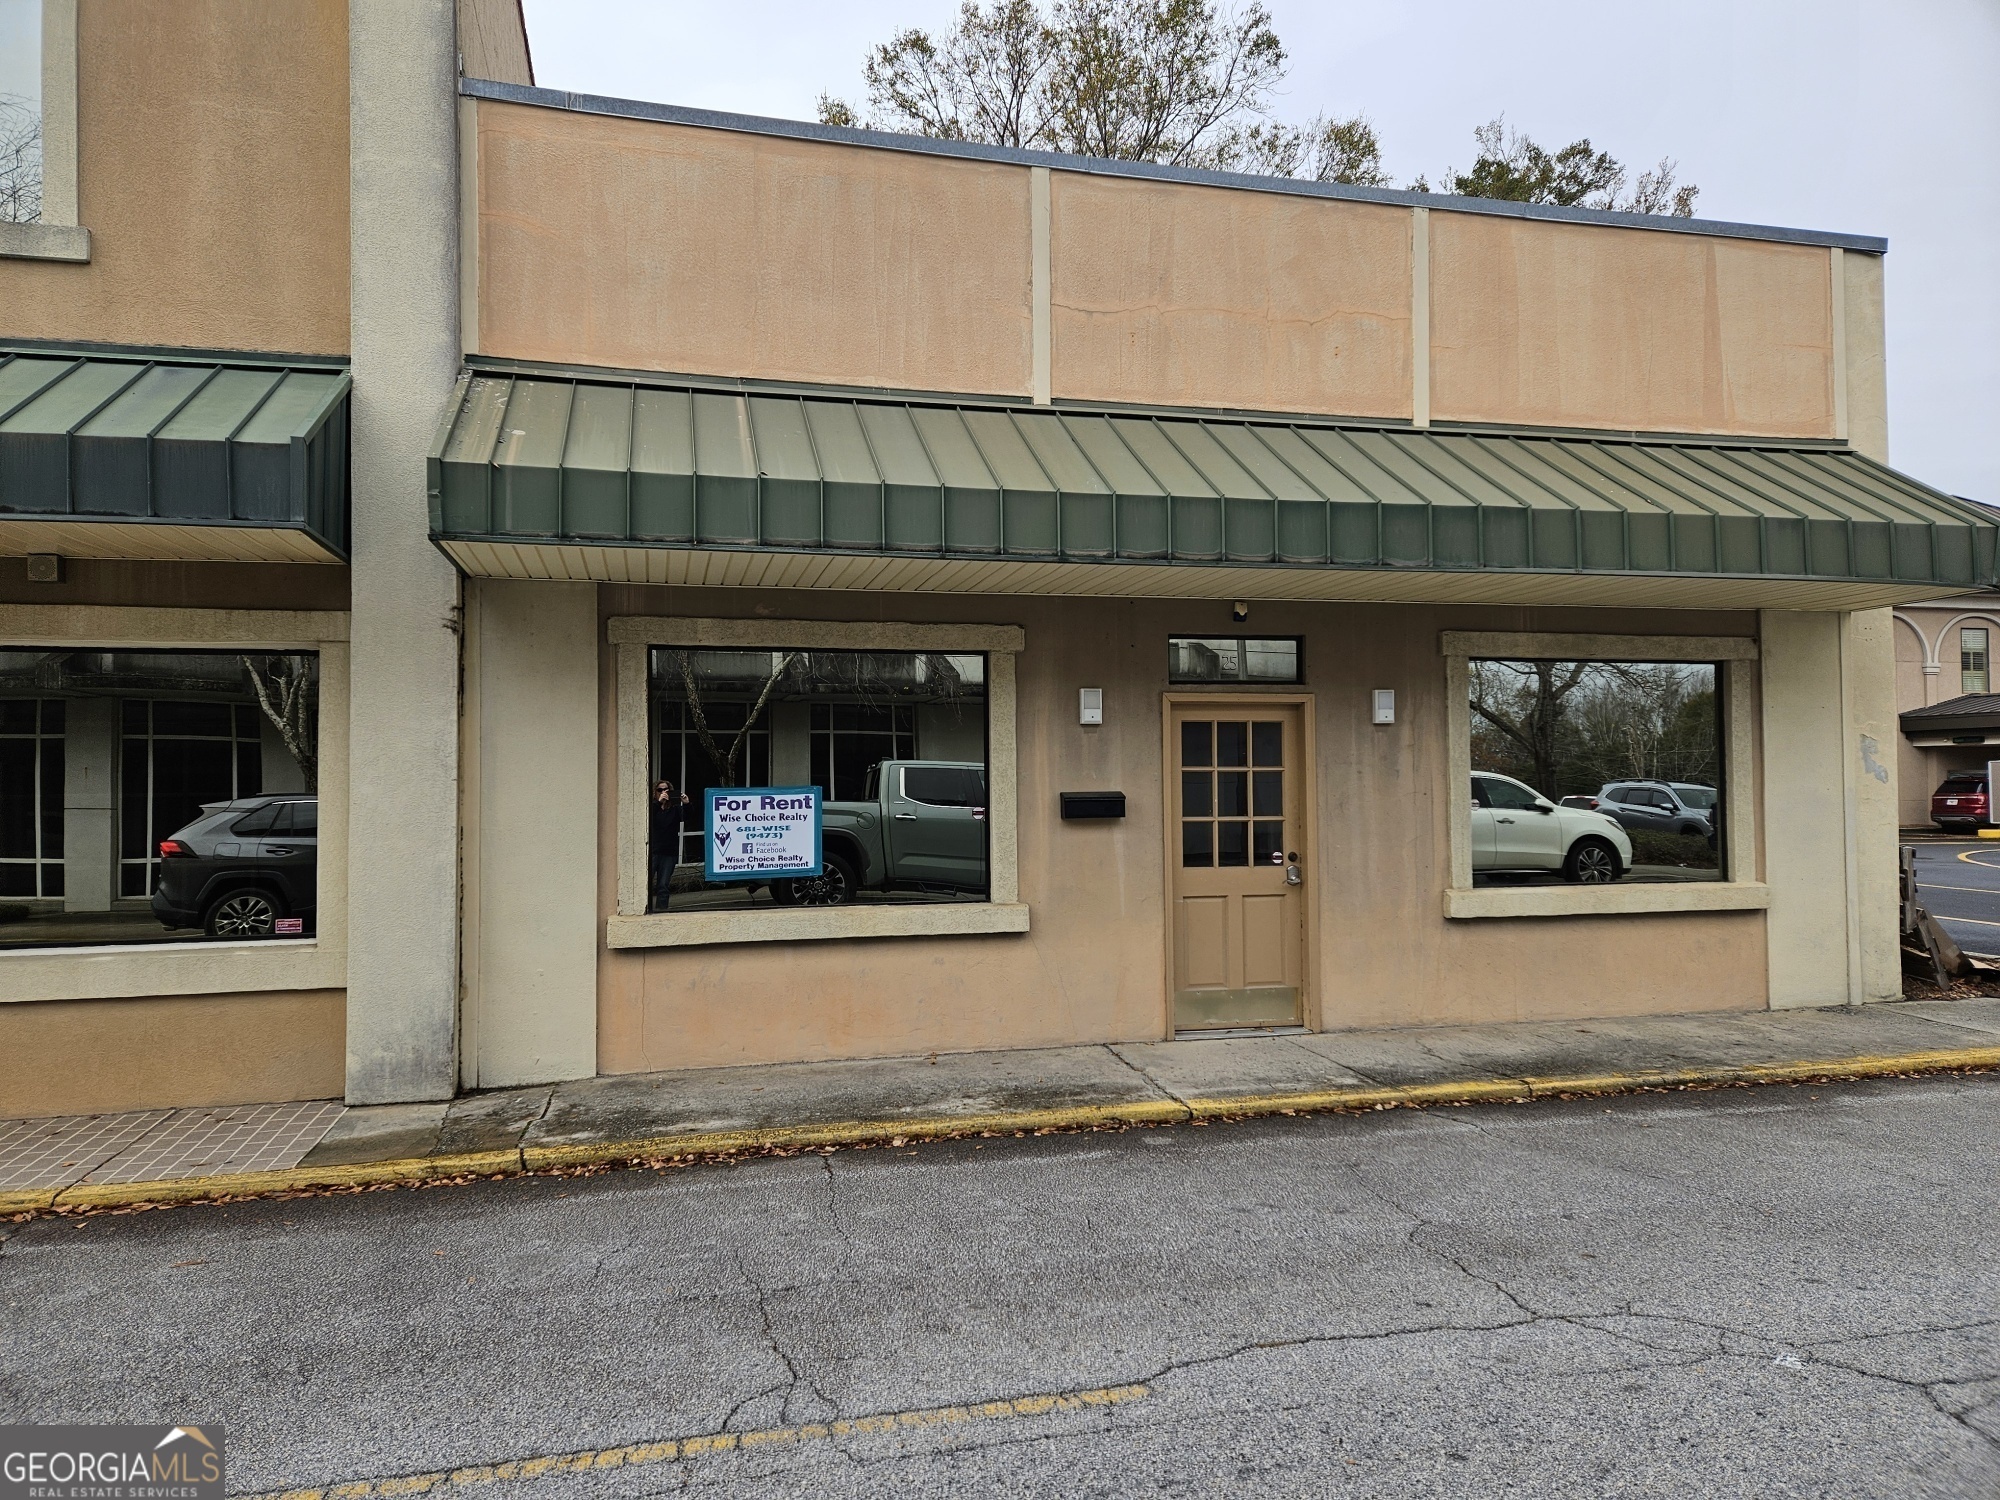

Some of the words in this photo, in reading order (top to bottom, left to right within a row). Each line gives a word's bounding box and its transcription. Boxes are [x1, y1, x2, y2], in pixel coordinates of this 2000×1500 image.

[715, 797, 751, 811] For
[761, 795, 812, 810] Rent
[719, 814, 741, 823] Wise
[745, 813, 776, 822] Choice
[779, 813, 808, 822] Realty
[746, 832, 783, 840] (9473)
[756, 846, 787, 854] Facebook
[748, 855, 775, 863] Choice
[778, 854, 803, 863] Realty
[719, 863, 755, 871] Property
[758, 861, 809, 869] Management
